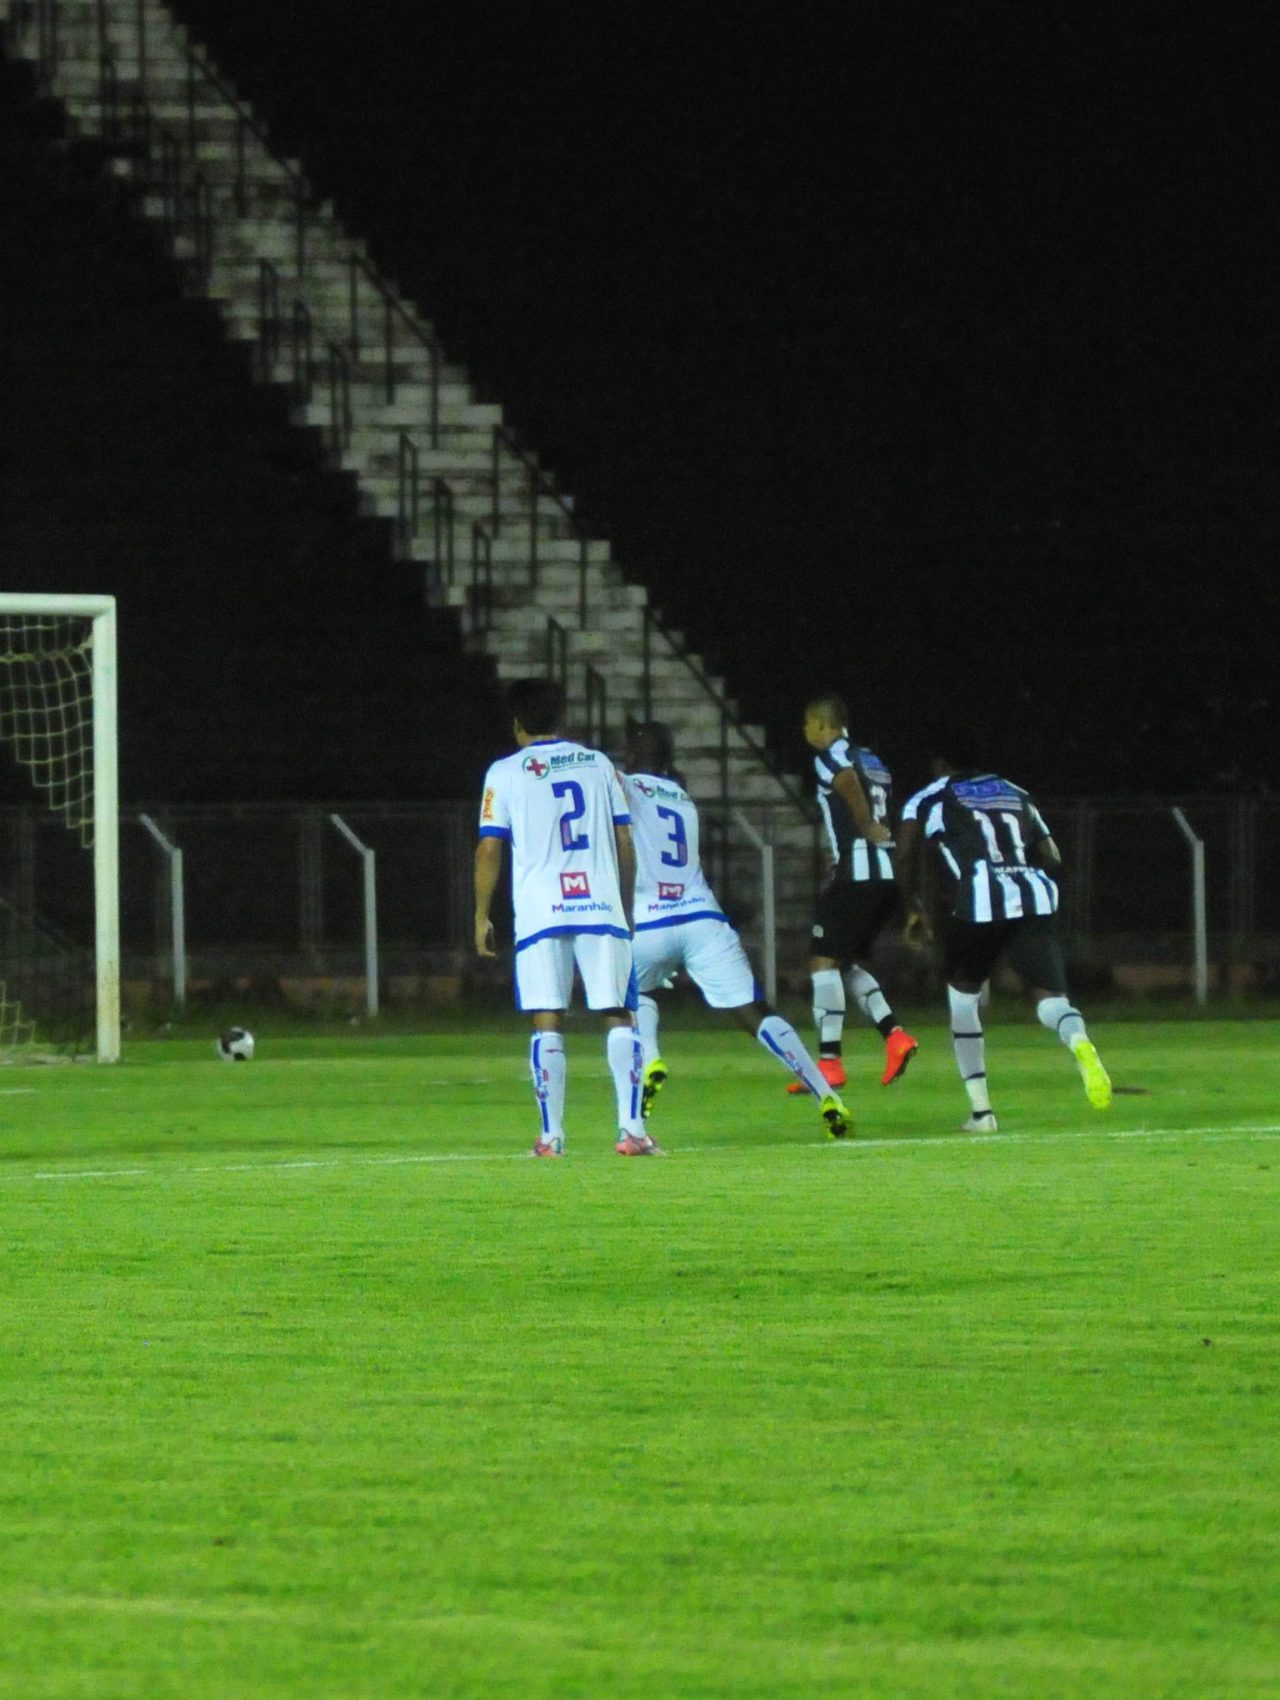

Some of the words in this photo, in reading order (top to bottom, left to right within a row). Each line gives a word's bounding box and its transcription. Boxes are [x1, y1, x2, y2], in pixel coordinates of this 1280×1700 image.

[550, 752, 576, 766] Med
[551, 780, 590, 852] 2
[656, 805, 688, 869] 3
[972, 809, 1027, 866] 11
[563, 876, 588, 892] M
